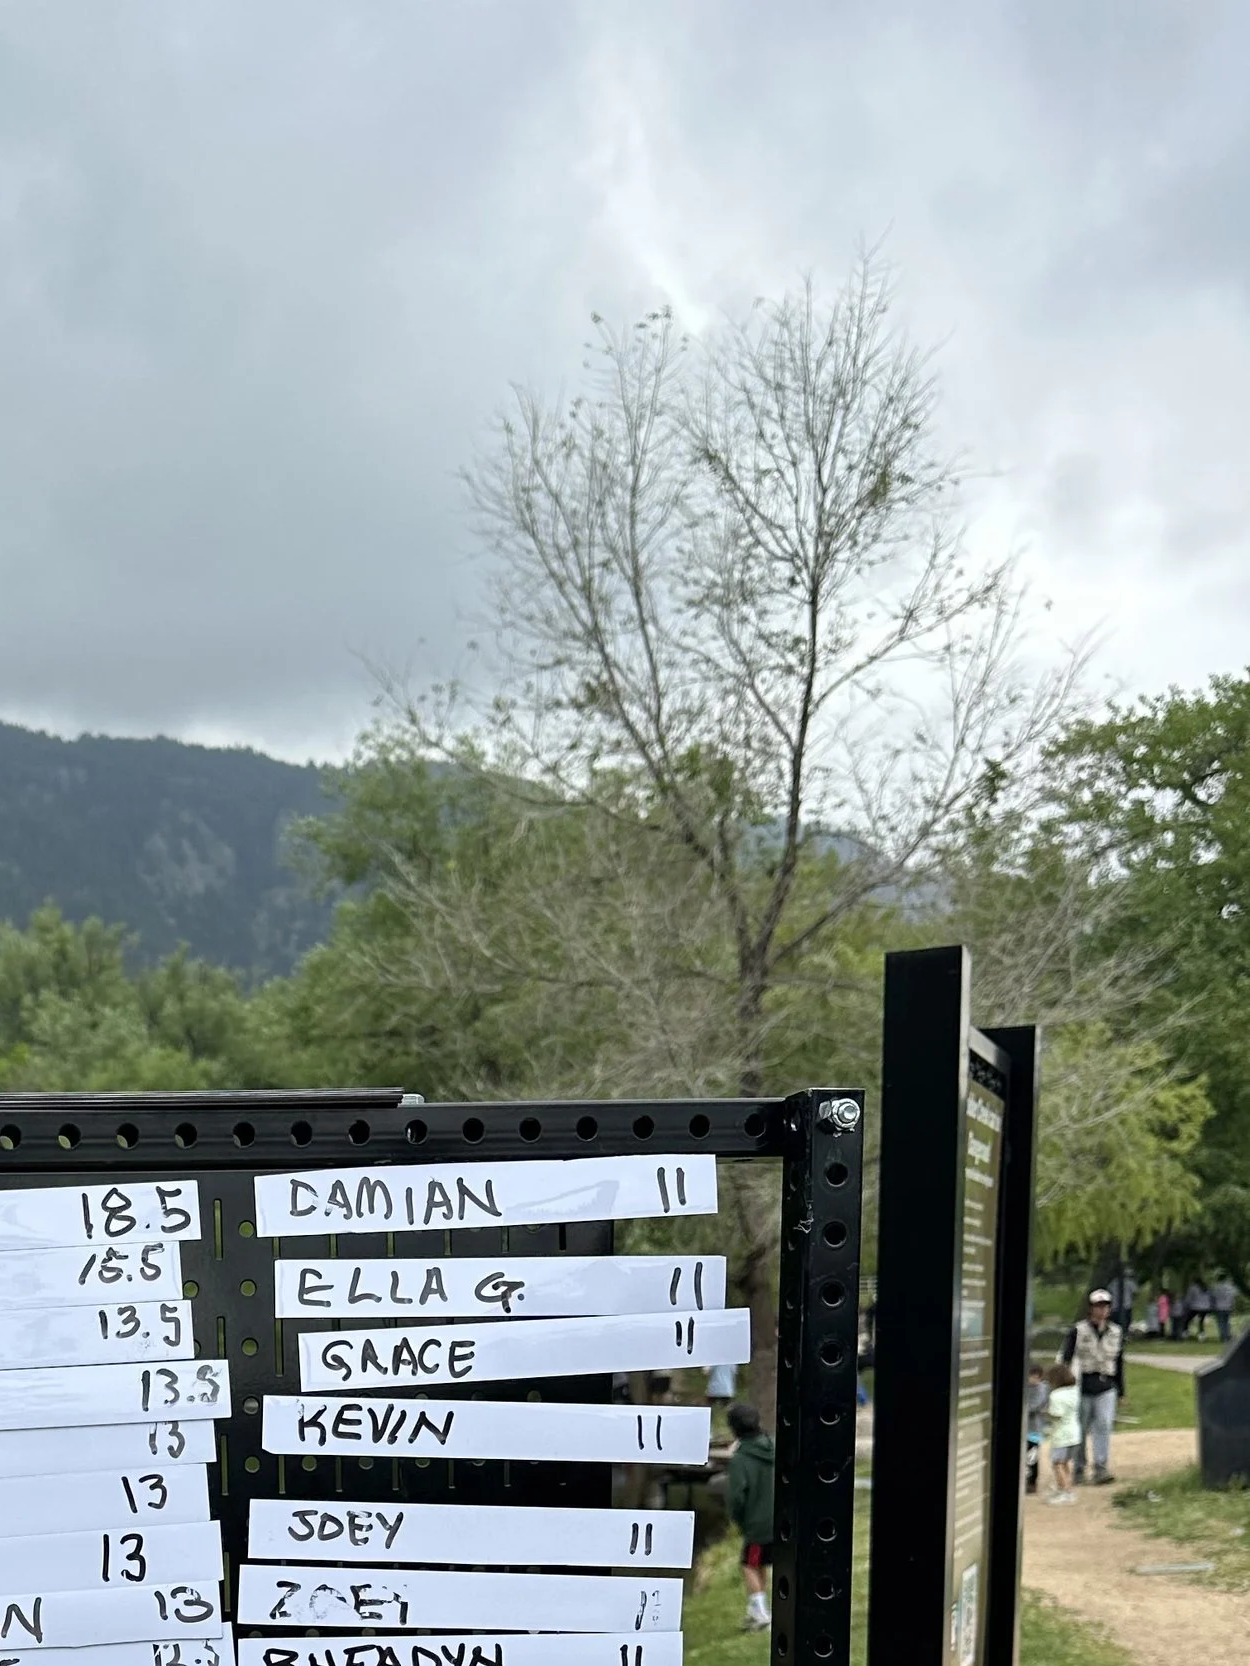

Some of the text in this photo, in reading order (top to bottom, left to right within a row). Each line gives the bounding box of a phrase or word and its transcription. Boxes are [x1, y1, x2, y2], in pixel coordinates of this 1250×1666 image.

[81, 1185, 191, 1240] 18.5
[289, 1166, 686, 1226] DAMIAN 11
[298, 1266, 448, 1308] ELLA
[668, 1261, 704, 1311] 11
[98, 1303, 182, 1347] 13.5
[321, 1317, 694, 1382] GRACE 11
[140, 1364, 222, 1412] 13.5
[149, 1421, 186, 1460] 13
[296, 1403, 664, 1451] KEVIN 11
[121, 1473, 168, 1514] 13
[287, 1509, 654, 1557] JOEY 11
[102, 1533, 147, 1582] 13
[155, 1586, 215, 1622] 13
